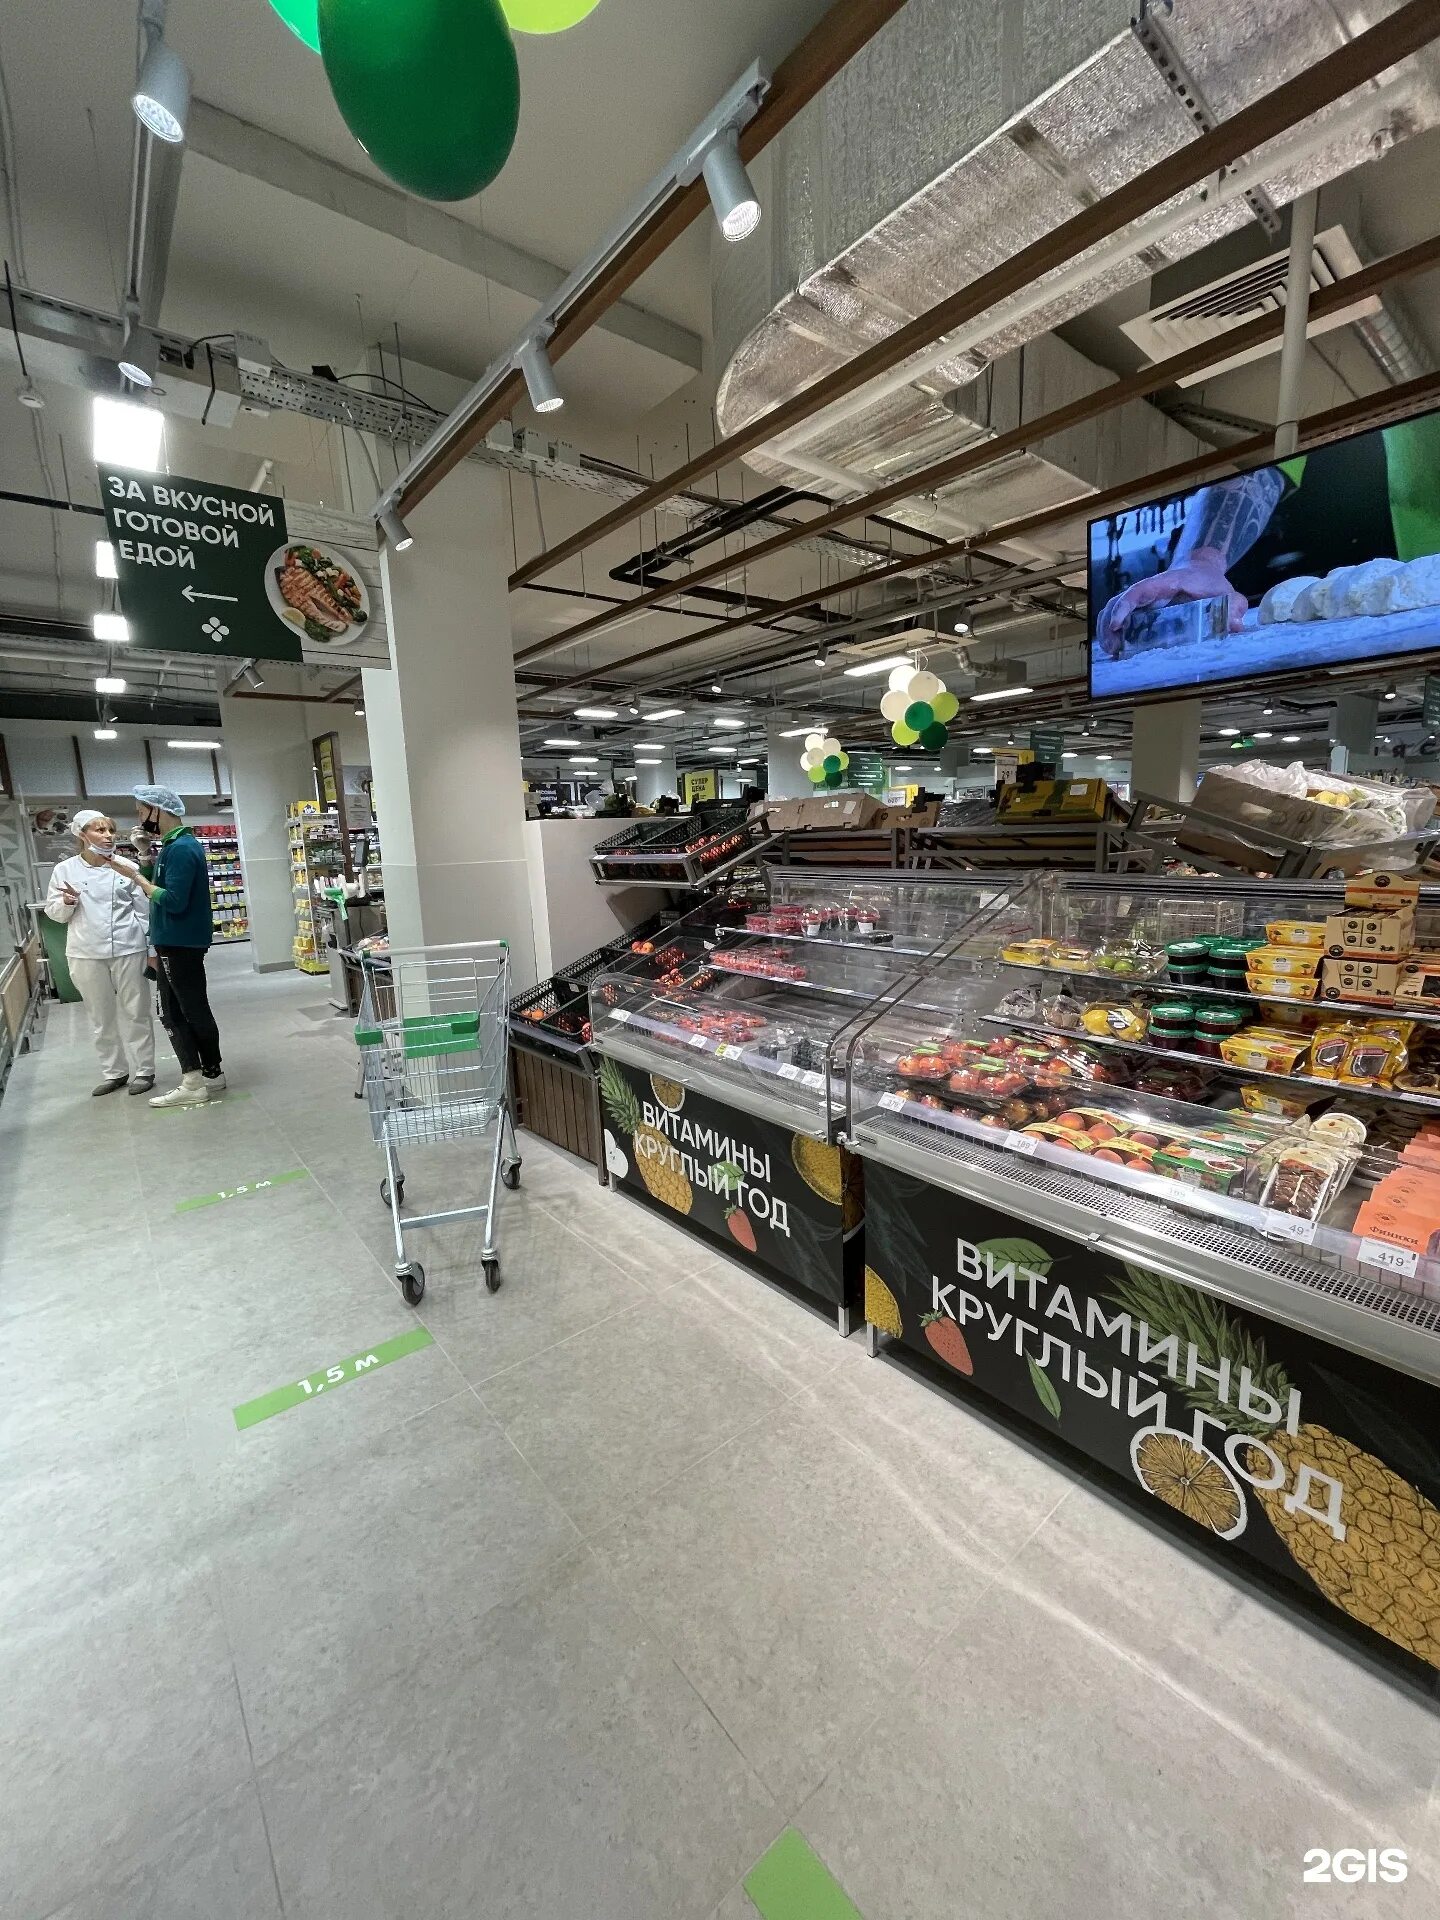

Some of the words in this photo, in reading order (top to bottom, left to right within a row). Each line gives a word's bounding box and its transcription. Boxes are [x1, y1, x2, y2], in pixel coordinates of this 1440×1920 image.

[107, 476, 147, 503] ЗА
[152, 484, 275, 528] ВКУСНОЙ
[113, 507, 240, 549] ГОТОВОЙ
[118, 539, 196, 570] ЕДОЙ
[691, 777, 708, 785] СУПЕР
[642, 1100, 771, 1184] ВИТАМИНЫ
[217, 1185, 248, 1198] 1,5
[635, 1130, 729, 1201] КРУГЛЫЙ
[737, 1180, 791, 1238] ГОД
[1288, 1223, 1305, 1236] 49
[1377, 1251, 1404, 1267] 419
[956, 1237, 1302, 1438] ВИТАМИНЫ
[297, 1364, 345, 1394] 1,5
[931, 1275, 1168, 1431] КРУГЛЫЙ
[1192, 1408, 1348, 1543] ГОД
